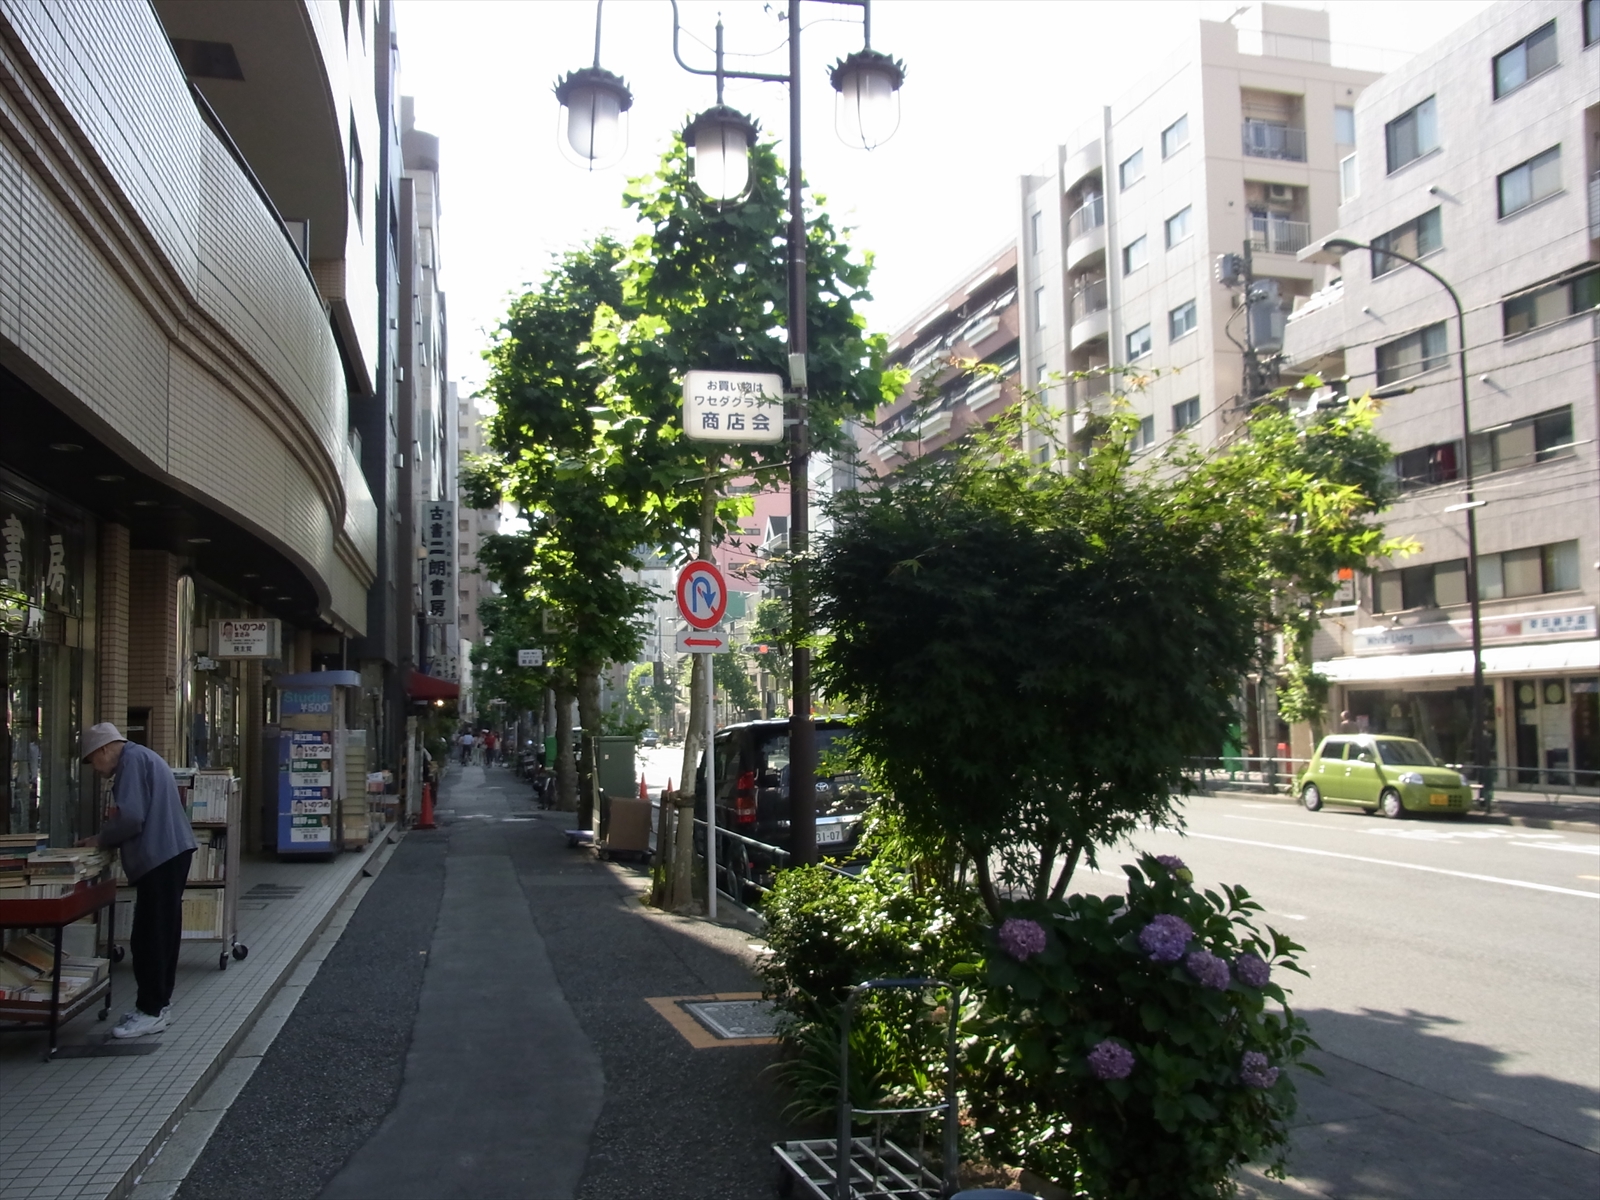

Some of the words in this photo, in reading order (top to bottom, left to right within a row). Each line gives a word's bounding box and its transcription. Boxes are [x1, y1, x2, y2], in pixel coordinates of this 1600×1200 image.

[707, 380, 764, 393] お買い物は
[694, 395, 774, 410] ワセダグラン
[701, 411, 770, 432] 商店会
[428, 505, 447, 618] 古書二朗書房
[234, 623, 266, 632] いのつめ
[1391, 633, 1414, 646] Living
[233, 645, 253, 653] 民主党
[283, 690, 330, 703] Studio
[300, 702, 328, 713] ¥500
